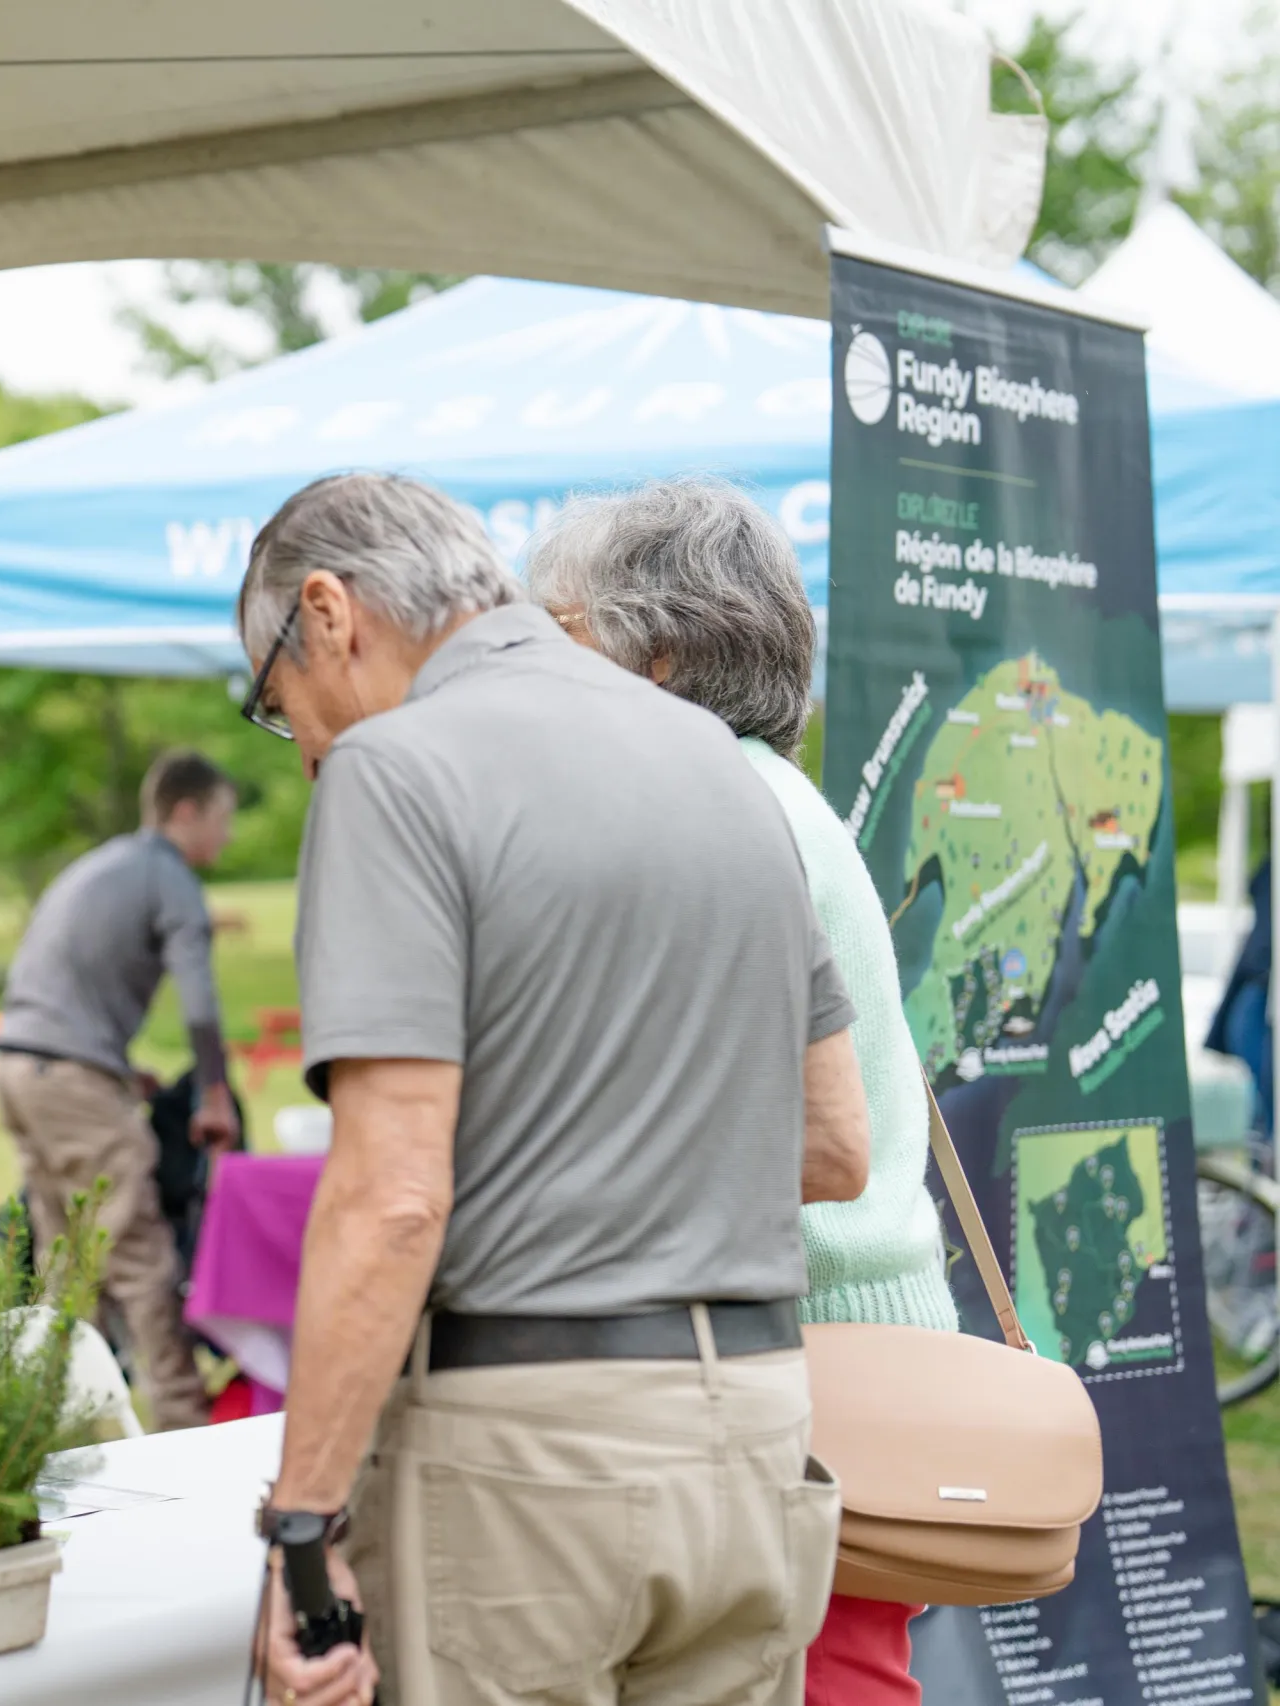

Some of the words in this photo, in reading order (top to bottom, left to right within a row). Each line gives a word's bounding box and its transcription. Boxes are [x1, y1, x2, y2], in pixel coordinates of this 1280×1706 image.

[897, 349, 972, 409] Fundy
[975, 365, 1079, 425] Biosphere
[897, 392, 981, 447] Region
[896, 529, 962, 573] Région
[964, 538, 995, 574] de
[997, 541, 1014, 576] la
[894, 570, 921, 606] de
[922, 575, 988, 619] Fundy
